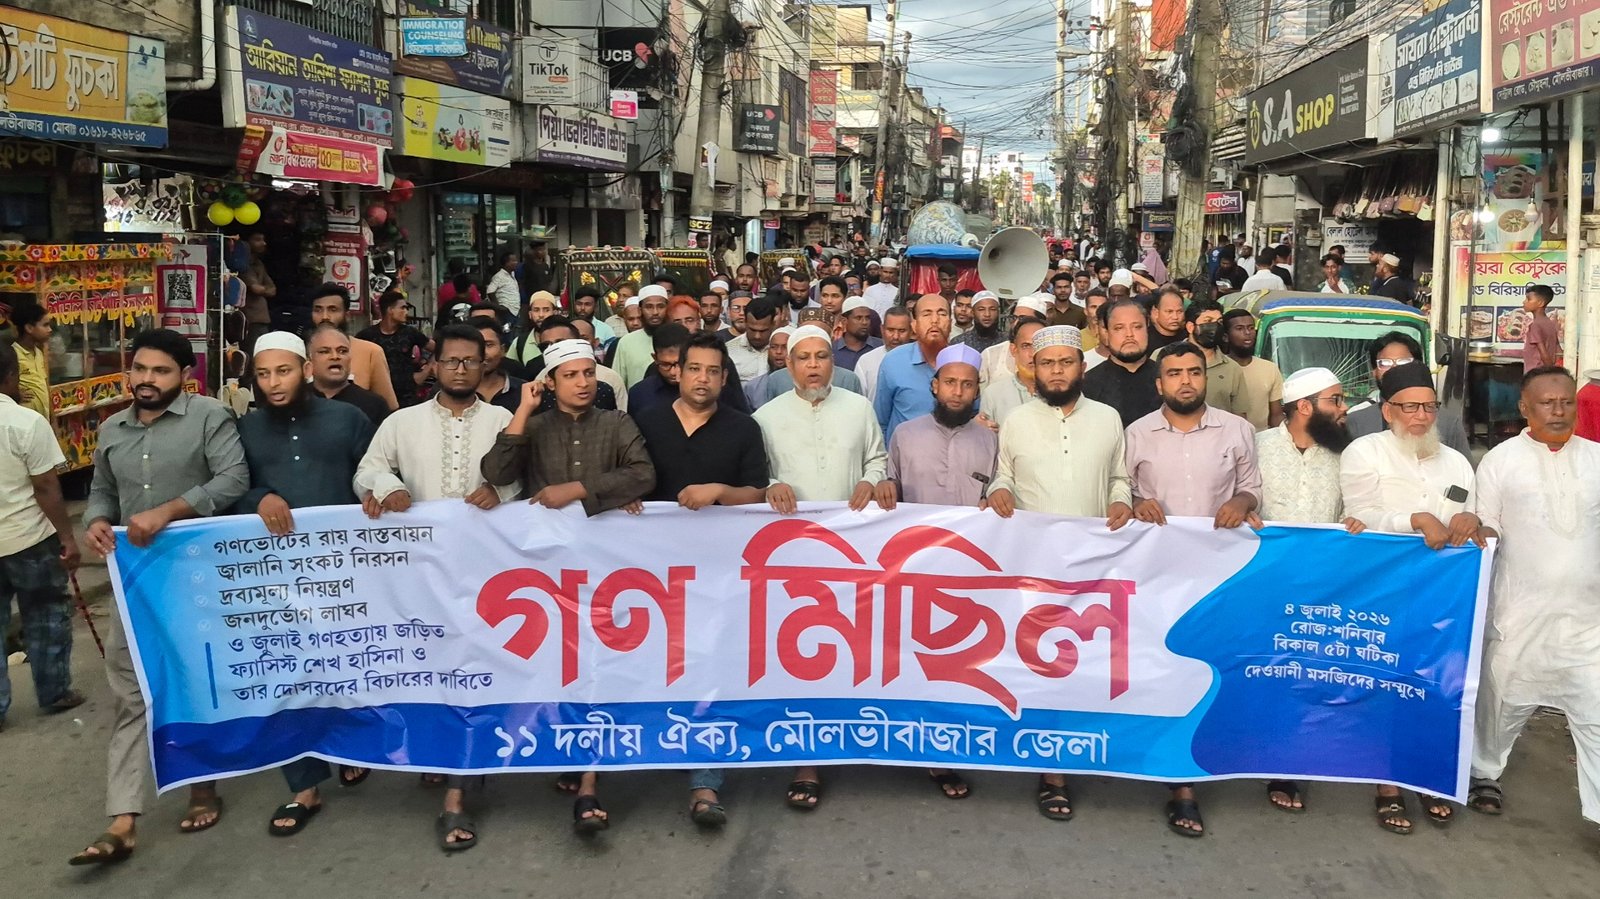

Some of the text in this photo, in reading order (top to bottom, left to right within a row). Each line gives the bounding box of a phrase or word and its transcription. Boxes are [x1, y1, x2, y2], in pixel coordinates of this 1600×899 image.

[529, 63, 569, 76] TikTok
[601, 49, 632, 62] UCB
[64, 48, 119, 111] ফুচকা
[1295, 93, 1335, 134] SHOP
[1207, 194, 1239, 208] হোটেল
[1509, 258, 1567, 279] রেস্টুরেন
[214, 525, 433, 555] গণভোটের রায় বাস্তবায়ন
[215, 547, 409, 581] জ্বালানি সংকট নিরসন
[218, 576, 354, 606] দ্রব্যমূল্য নিয়ন্ত্রণ
[222, 601, 368, 631] জনদুর্ভোগ লাঘব
[476, 518, 1137, 716] গণ মিছিল
[1284, 603, 1390, 626] ৪ জুলাই ২০২৬
[228, 618, 445, 655] ও জুলাই গণহত্যায় জড়িত
[1273, 633, 1401, 667] বিকাল ৫টা ঘটিকা
[228, 644, 427, 679] ফ্যাসিস্ট শেখ হাসিনা ও
[232, 668, 493, 701] তার দোসরদের বিচারের দাবিতে
[1244, 661, 1426, 701] দেওয়ানী মসজিদের সম্মুখে
[495, 706, 1111, 765] ১১ দলীয় ঐক্য, মৌলভীবাজার জেলা
